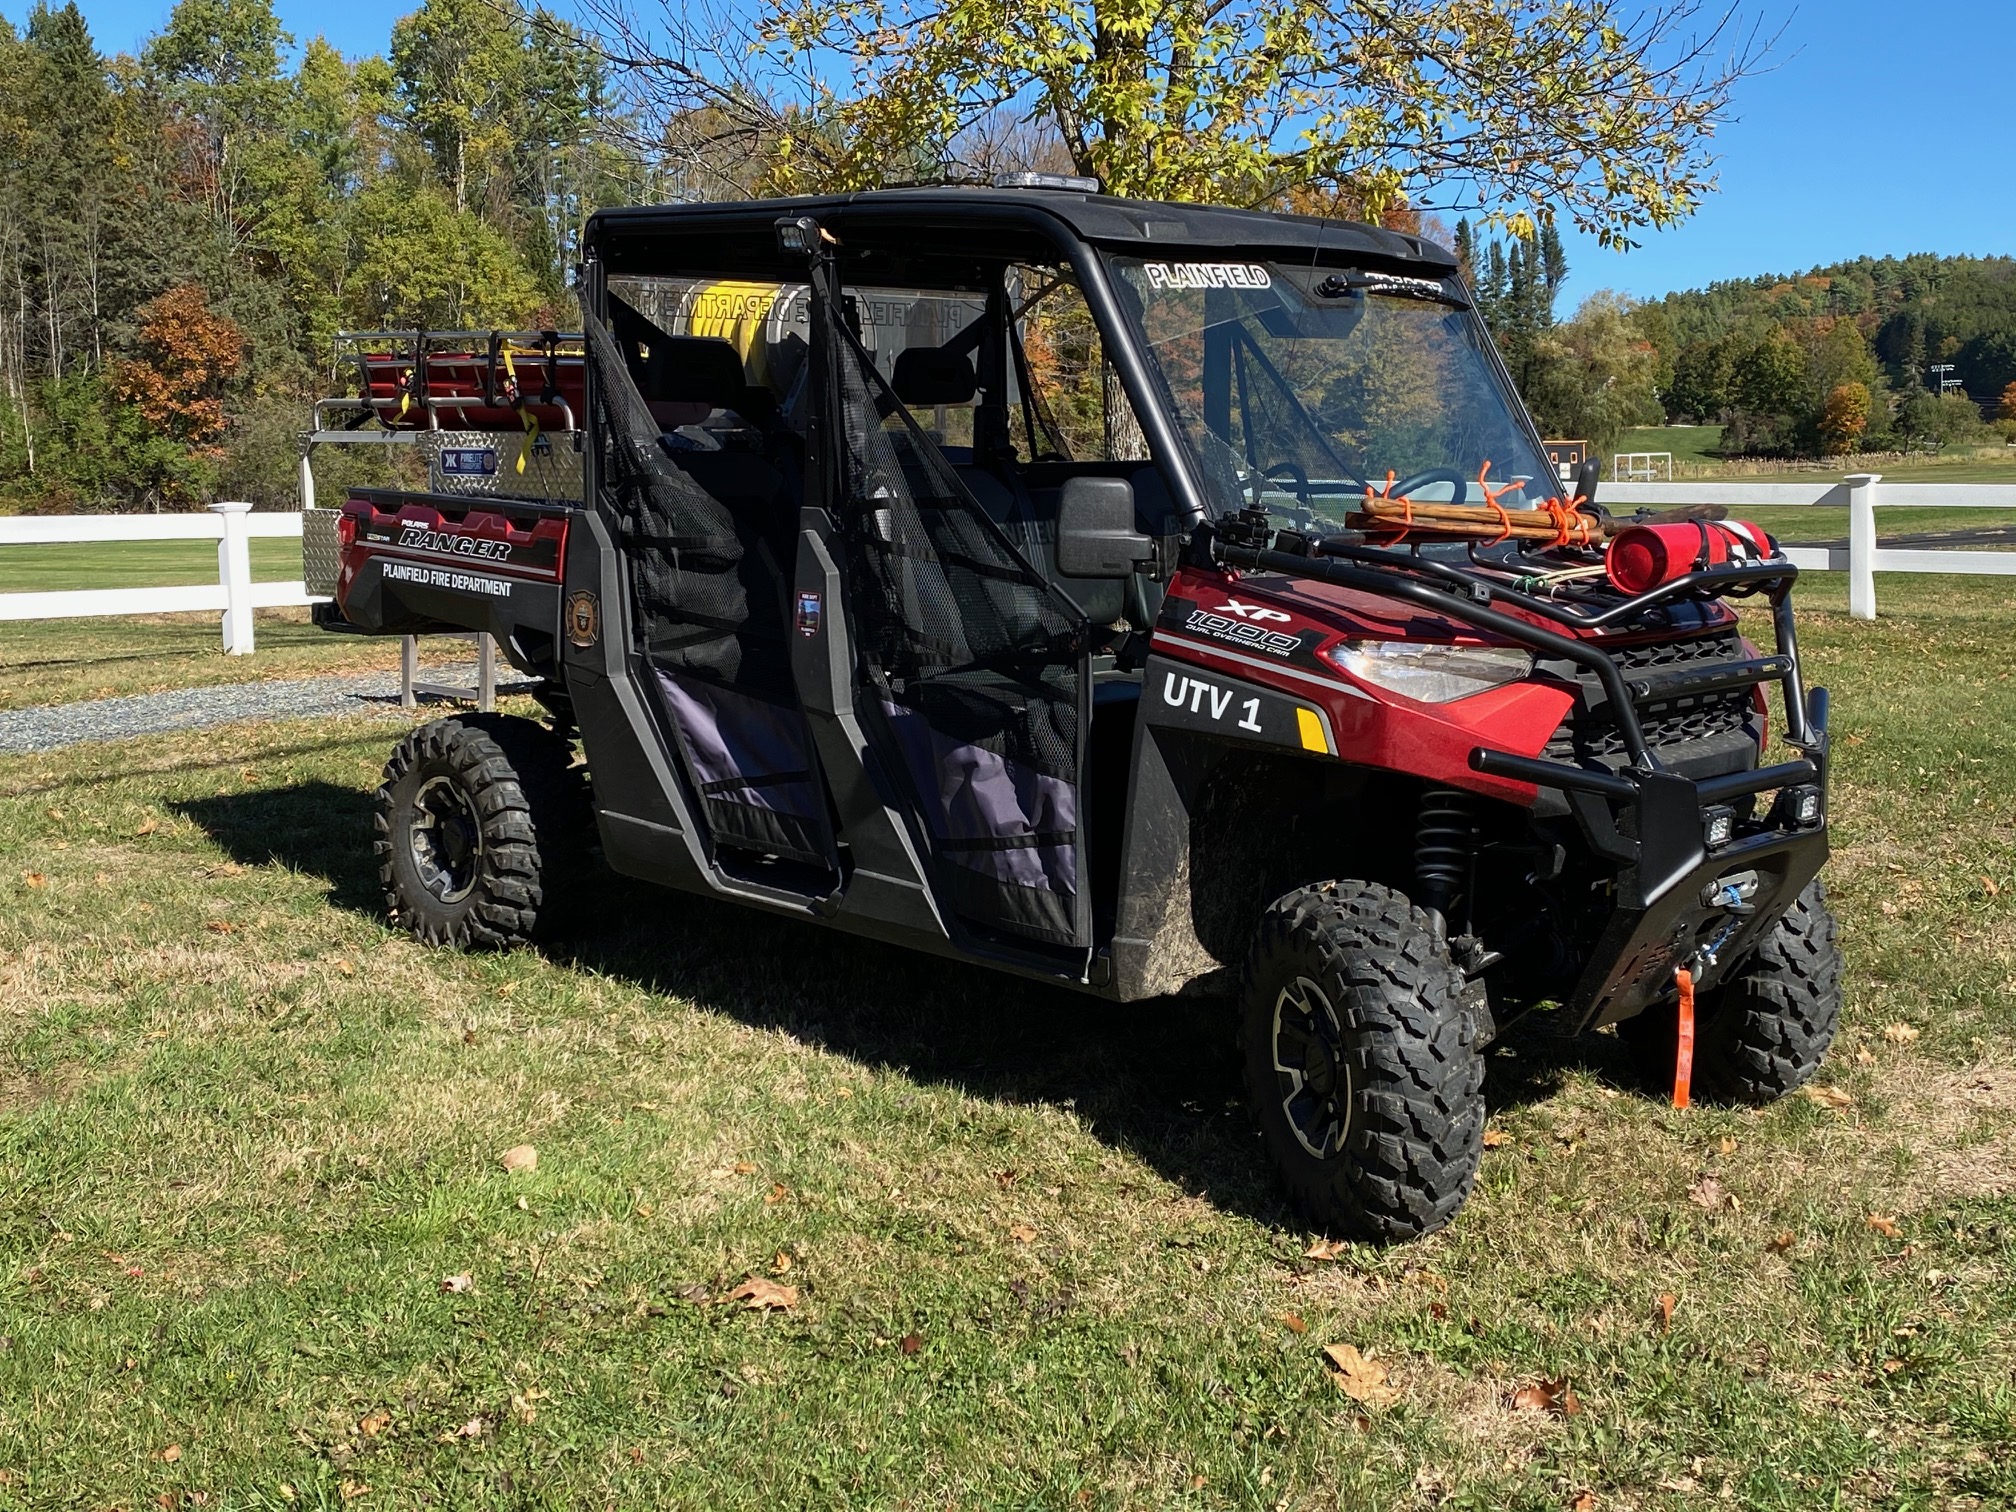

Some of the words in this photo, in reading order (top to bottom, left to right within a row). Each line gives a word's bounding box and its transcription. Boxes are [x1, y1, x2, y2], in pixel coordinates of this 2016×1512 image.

[1144, 263, 1271, 290] PLAINFIELD
[401, 519, 429, 530] POLARIS
[398, 528, 512, 561] RANGER
[383, 563, 429, 585] PLAINFIELD
[430, 569, 451, 588] FIRE
[451, 574, 512, 597] DEPARTMENT
[1213, 598, 1292, 623] XP
[1185, 609, 1303, 652] 1000
[1185, 624, 1210, 635] DUAL
[1212, 631, 1266, 651] OVERHEAD
[1266, 645, 1291, 657] CAM
[1162, 671, 1234, 720] UTV
[1238, 697, 1263, 733] 1
